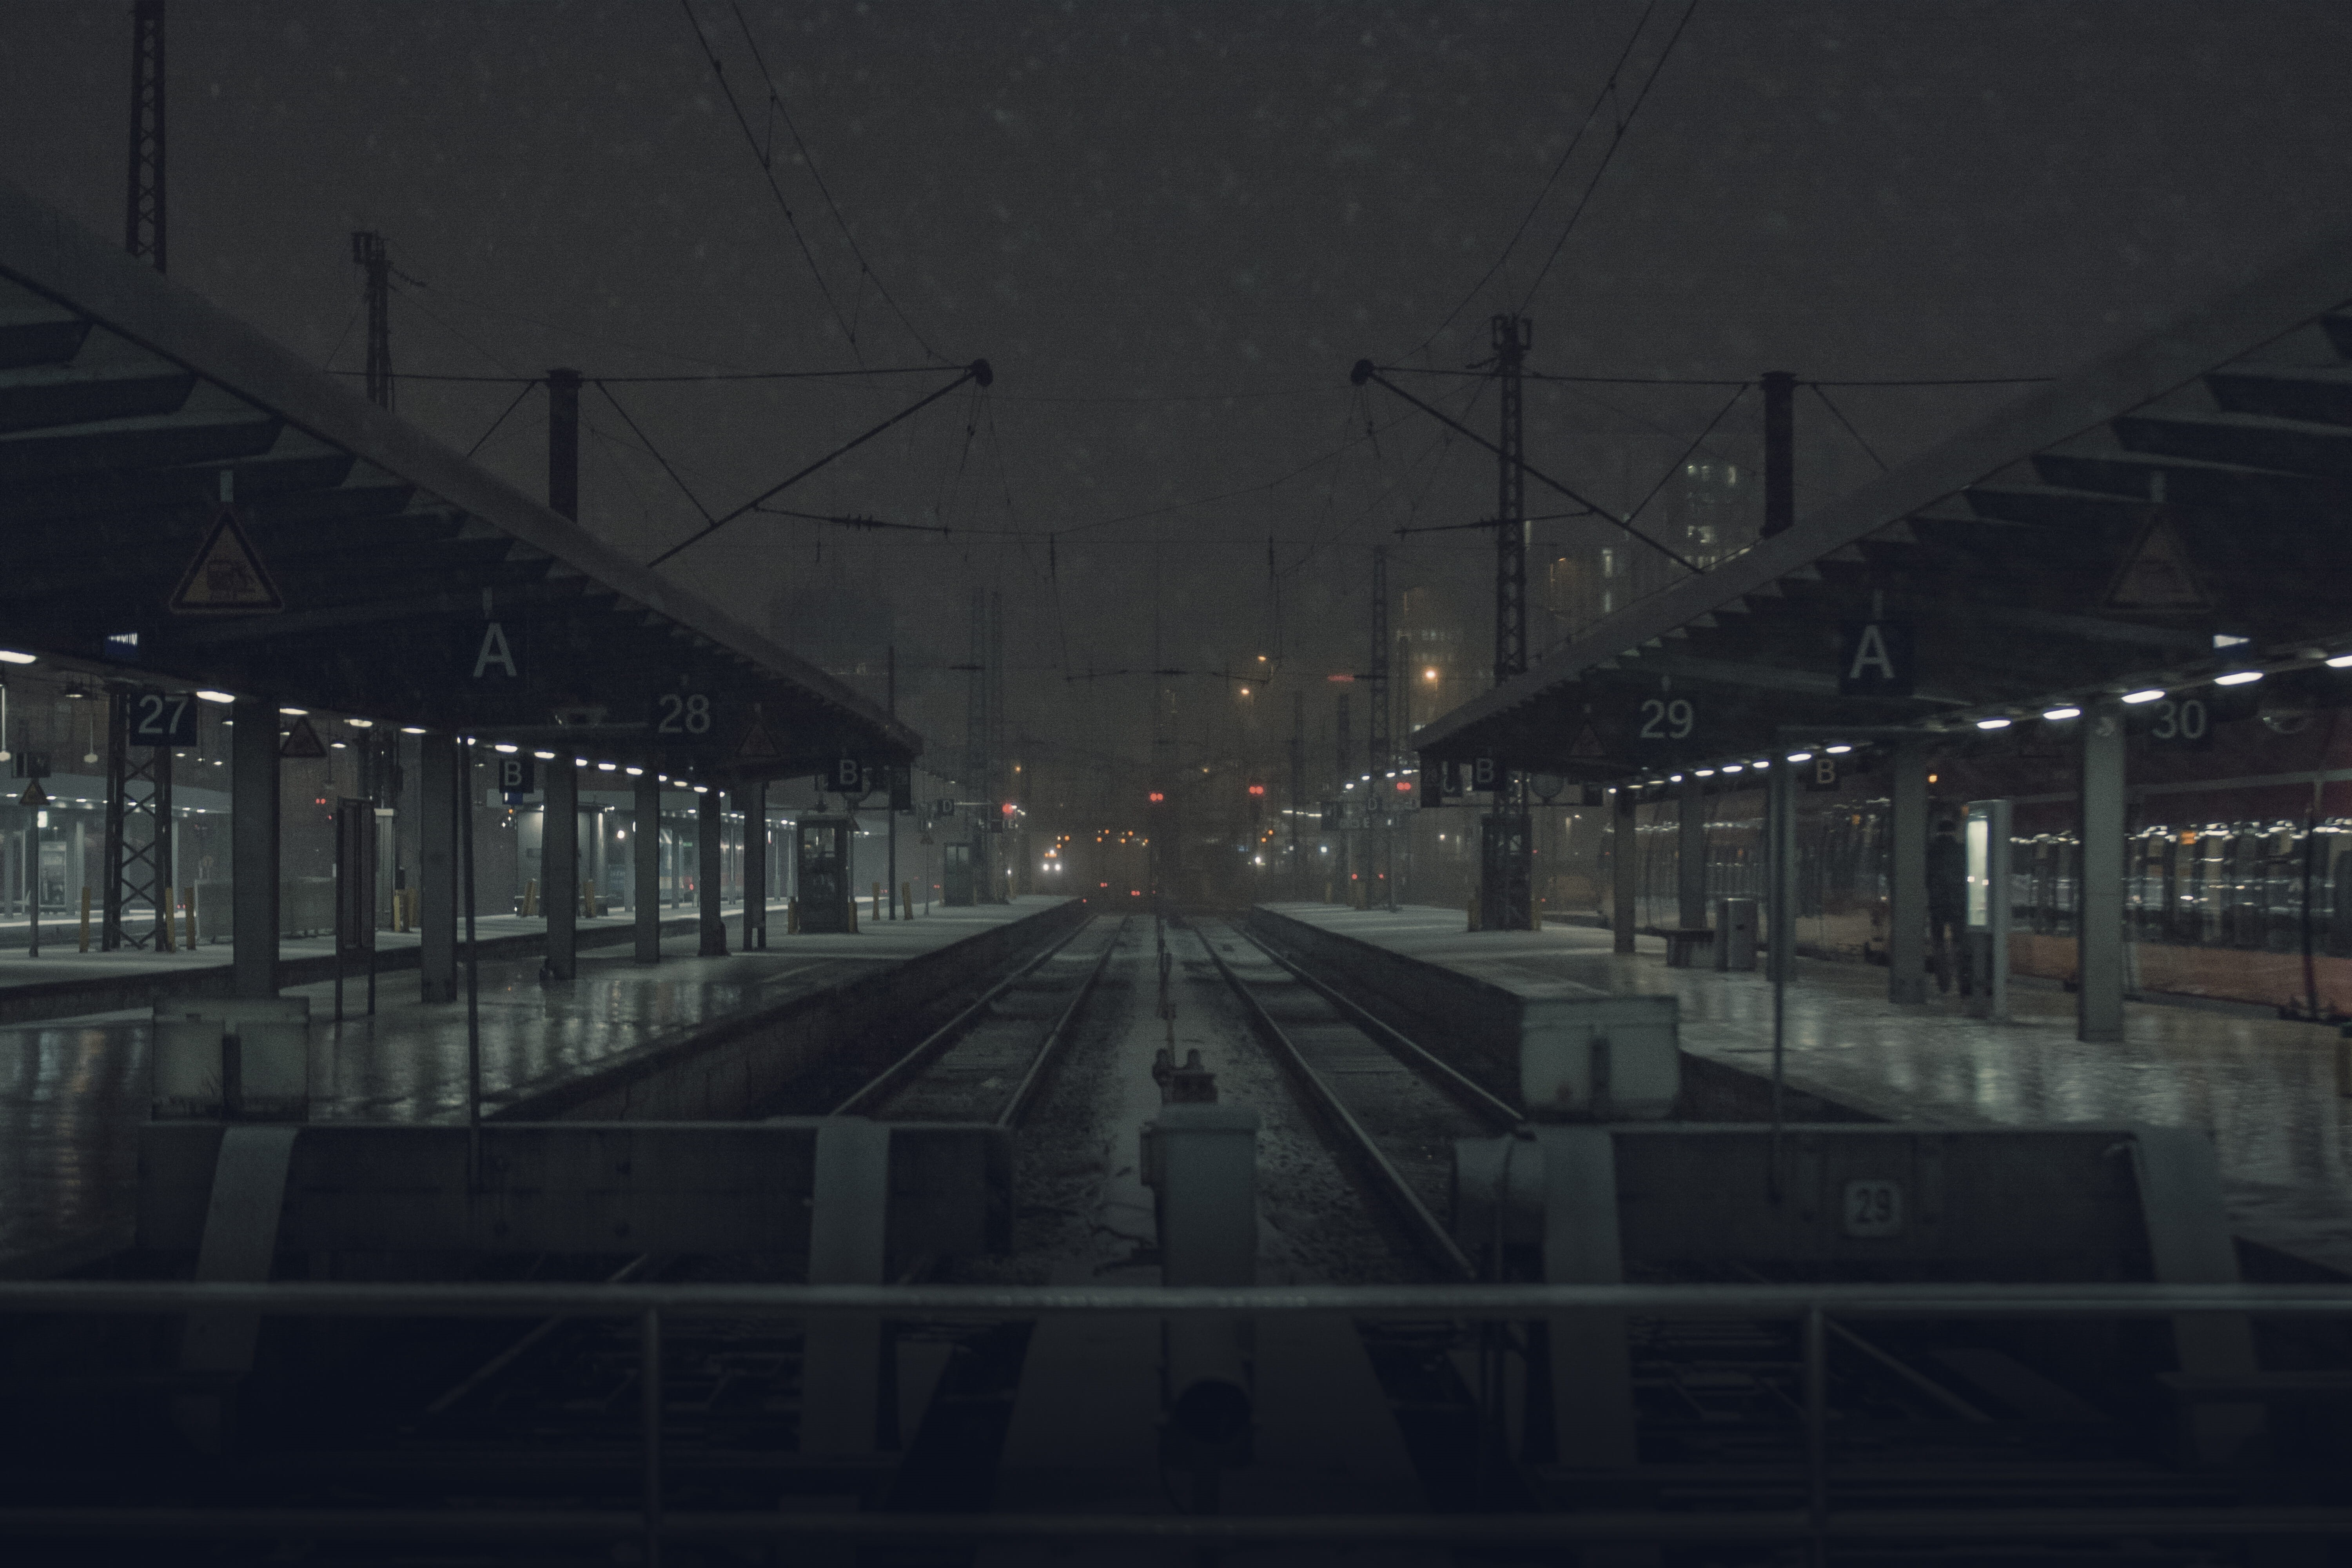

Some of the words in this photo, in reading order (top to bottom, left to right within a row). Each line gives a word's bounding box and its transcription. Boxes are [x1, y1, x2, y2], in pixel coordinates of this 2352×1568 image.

[473, 622, 517, 678] A
[1849, 624, 1895, 679] A
[138, 694, 189, 735] 27
[658, 693, 710, 734] 28
[1640, 699, 1694, 739] 29
[2152, 699, 2207, 739] 30
[504, 761, 523, 786] B
[839, 759, 858, 785] B
[1476, 758, 1494, 783] B
[1816, 759, 1836, 784] B
[943, 800, 952, 813] D
